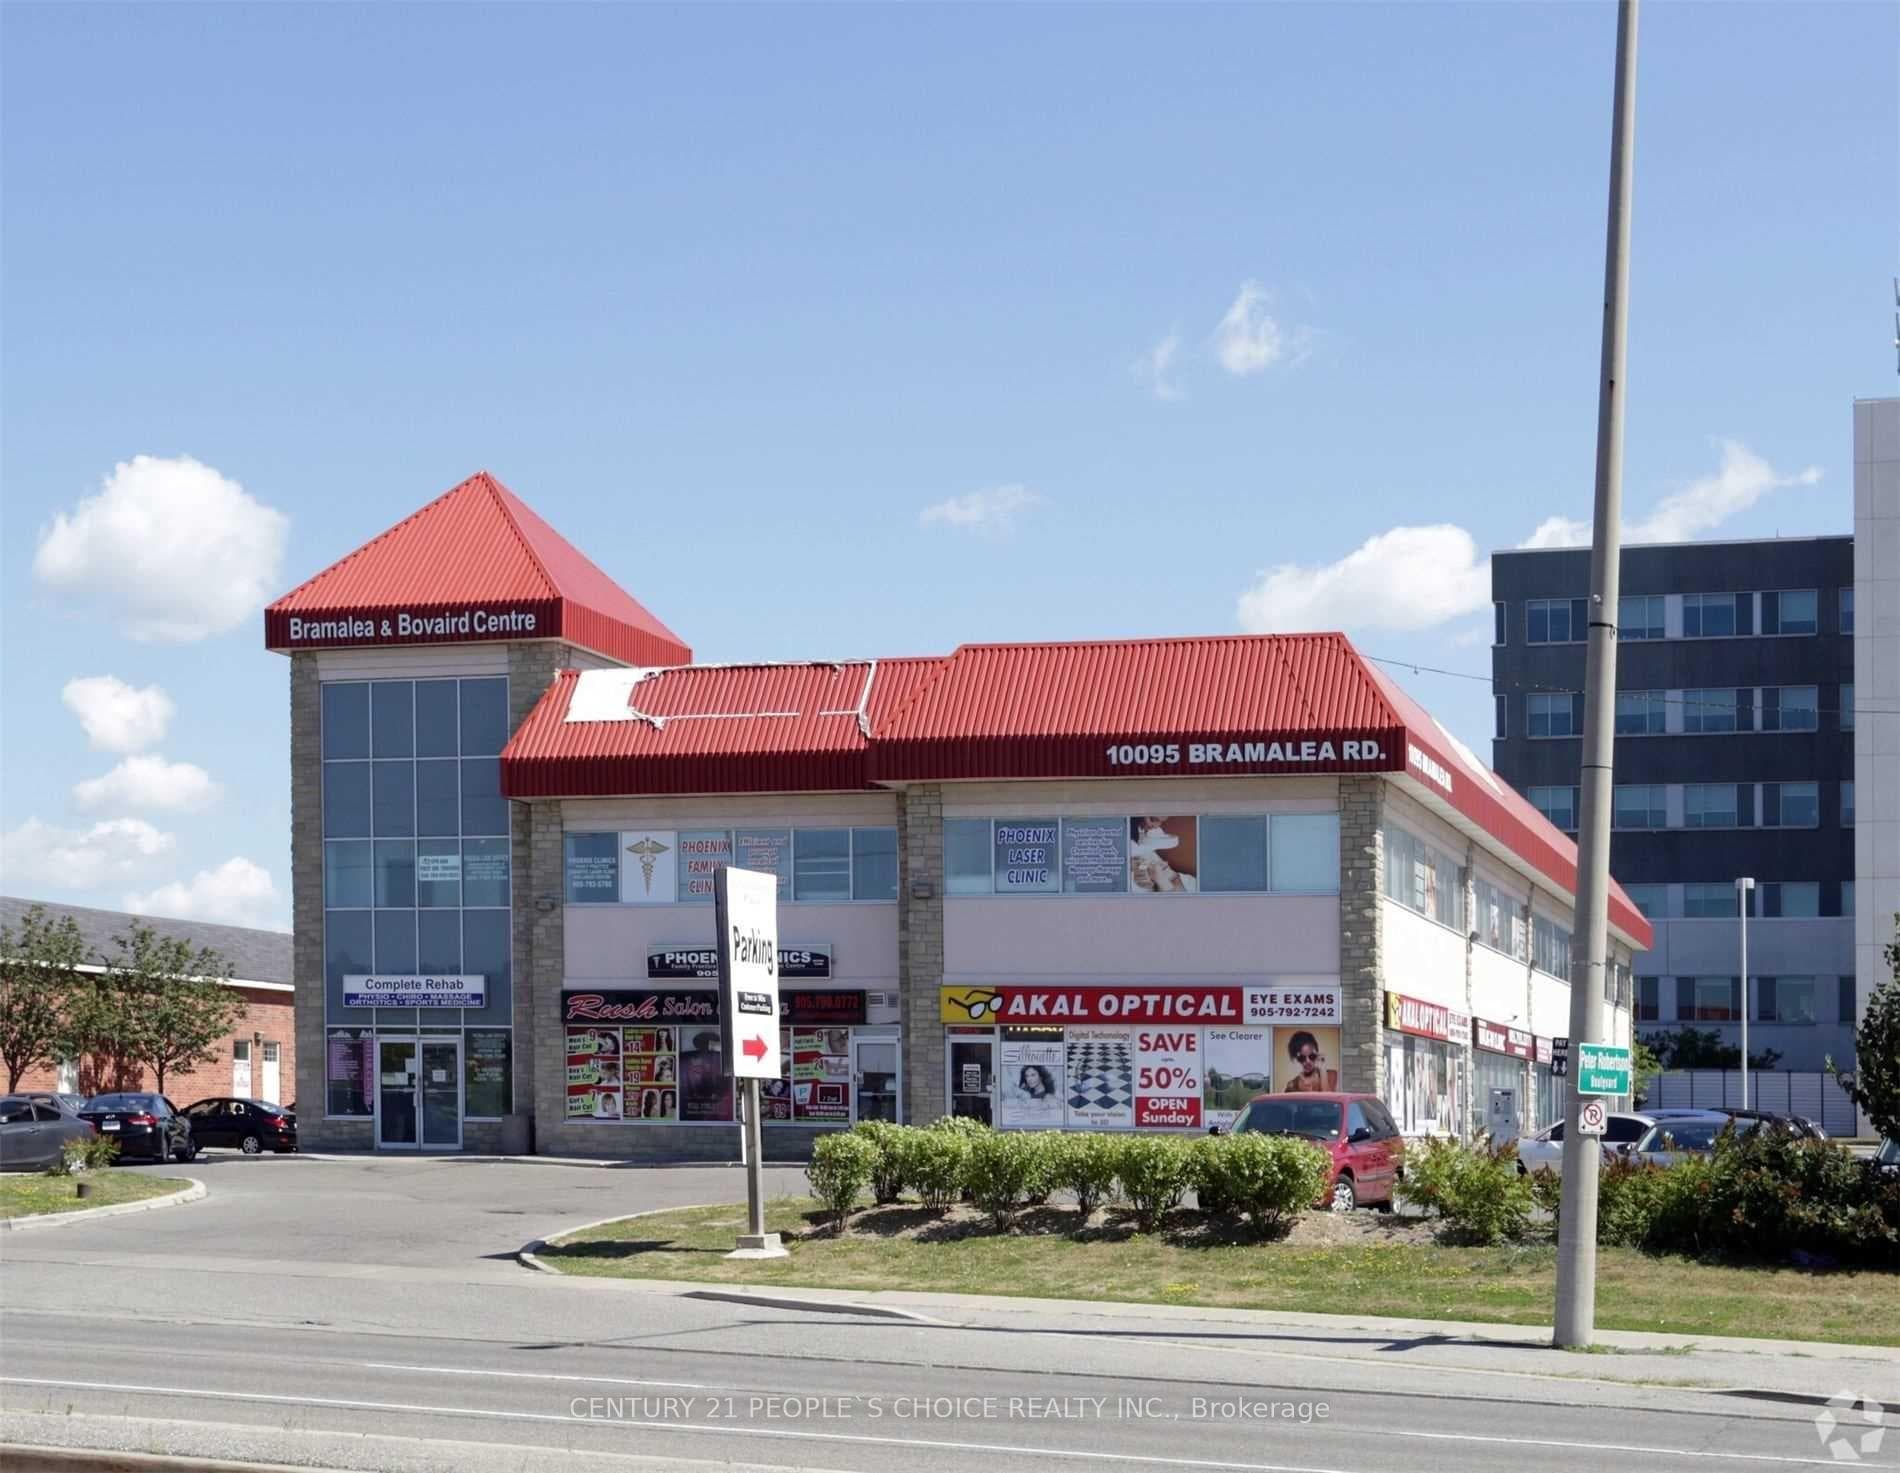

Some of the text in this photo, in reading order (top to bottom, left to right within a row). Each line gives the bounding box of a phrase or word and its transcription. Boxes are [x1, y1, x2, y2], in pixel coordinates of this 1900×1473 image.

[290, 610, 536, 639] Bramalea & Bovaird Centre
[1106, 741, 1387, 766] 10095 BRAMALEA RD.
[998, 828, 1055, 843] PHOENIX
[680, 840, 730, 853] PHOENIX
[1008, 849, 1045, 863] LASER
[1007, 869, 1048, 884] CLINIC
[688, 880, 713, 894] CLIN
[665, 952, 718, 964] PHOEN
[733, 925, 773, 976] Parking
[365, 978, 464, 991] Complete Rehab
[662, 997, 712, 1016] Salon
[1008, 994, 1236, 1017] AKAL OPTICAL
[1251, 994, 1334, 1005] EYE EXAMS
[1251, 1007, 1335, 1018] 905-792-7242
[1138, 1033, 1197, 1052] SAVE
[1209, 1031, 1264, 1040] See Clearer
[1580, 1050, 1597, 1069] Peter
[1138, 1066, 1197, 1089] 50%
[1148, 1098, 1188, 1111] OPEN
[1142, 1112, 1195, 1127] Sunday
